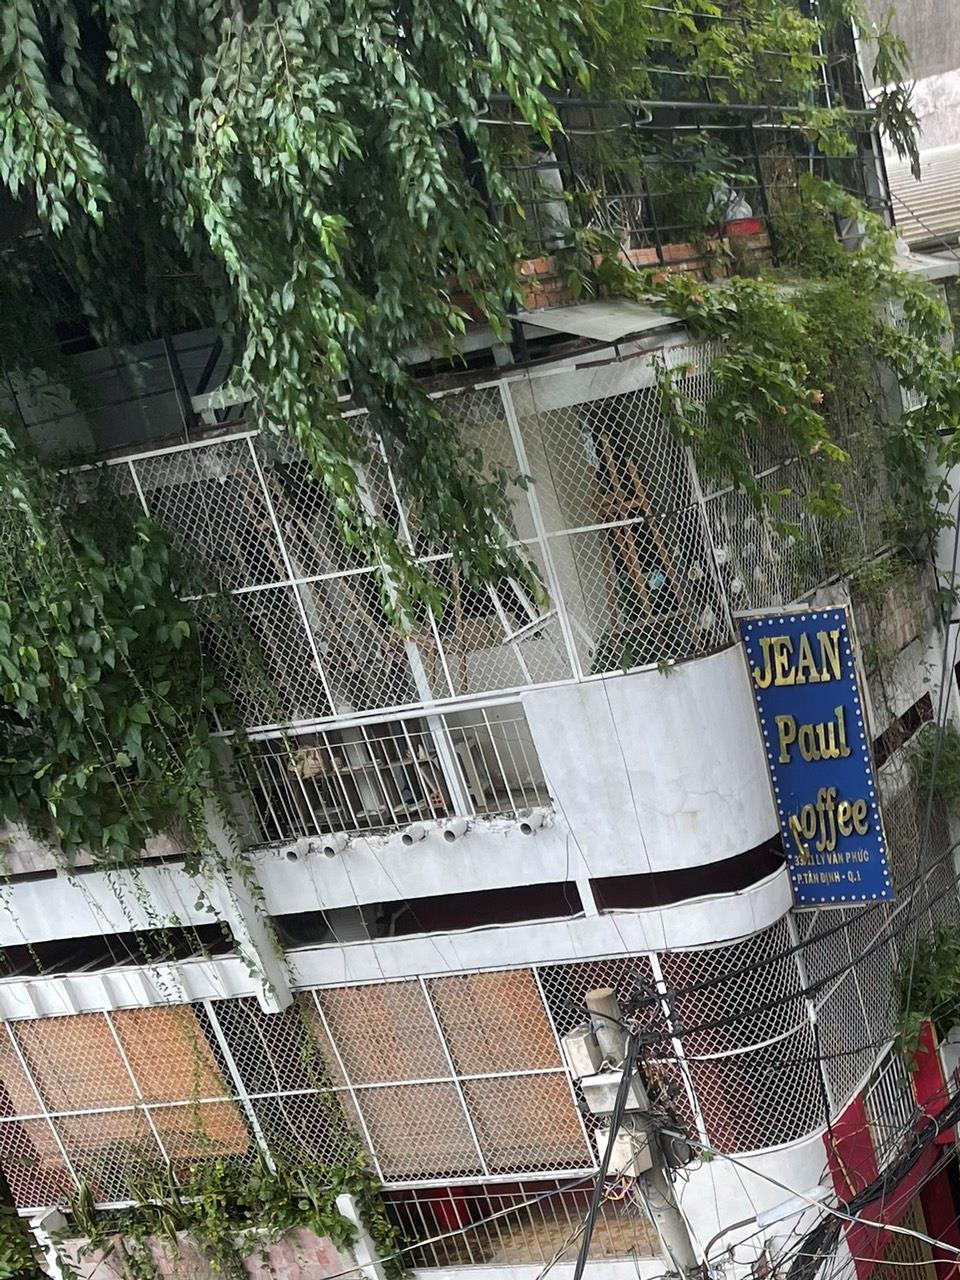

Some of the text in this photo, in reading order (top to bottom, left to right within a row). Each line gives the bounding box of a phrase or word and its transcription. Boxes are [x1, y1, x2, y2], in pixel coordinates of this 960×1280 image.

[755, 629, 842, 689] JEAN
[775, 705, 851, 763] Paul
[847, 870, 861, 883] Q.1
